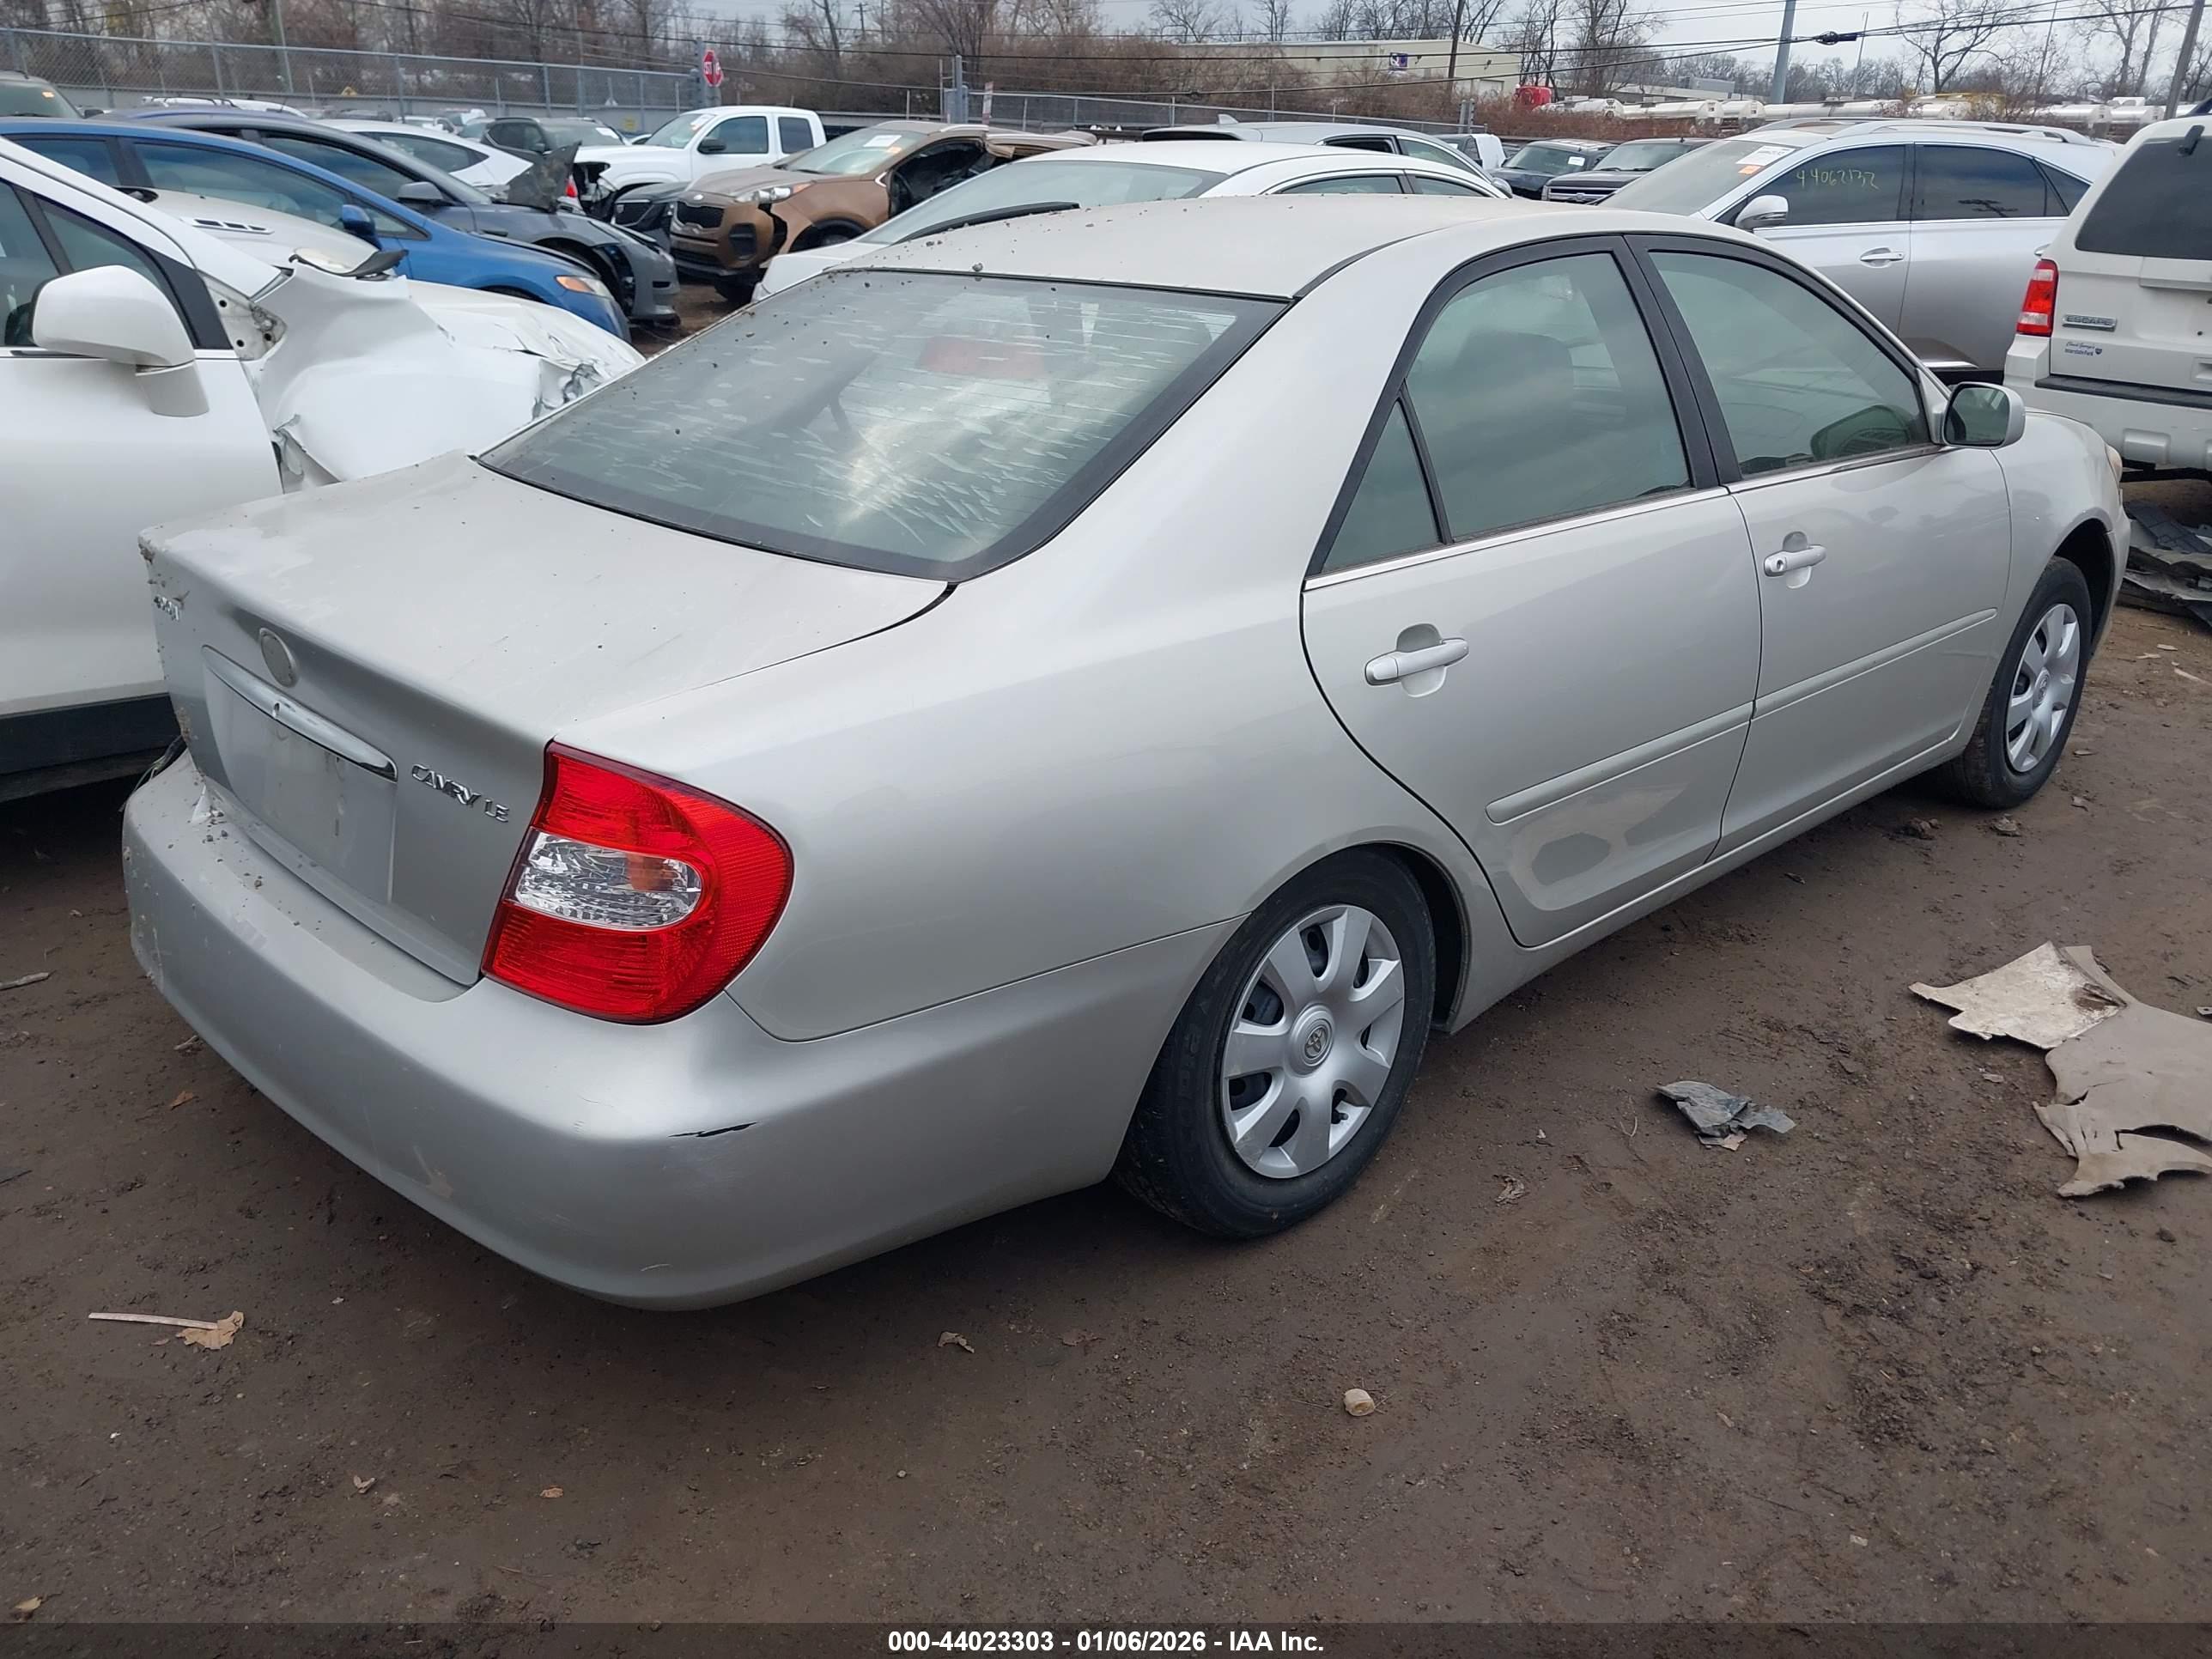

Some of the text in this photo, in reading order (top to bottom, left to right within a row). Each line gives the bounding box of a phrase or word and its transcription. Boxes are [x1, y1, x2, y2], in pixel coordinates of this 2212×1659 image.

[2065, 314, 2115, 326] ESCAPE
[412, 763, 509, 823] CAMRY LE
